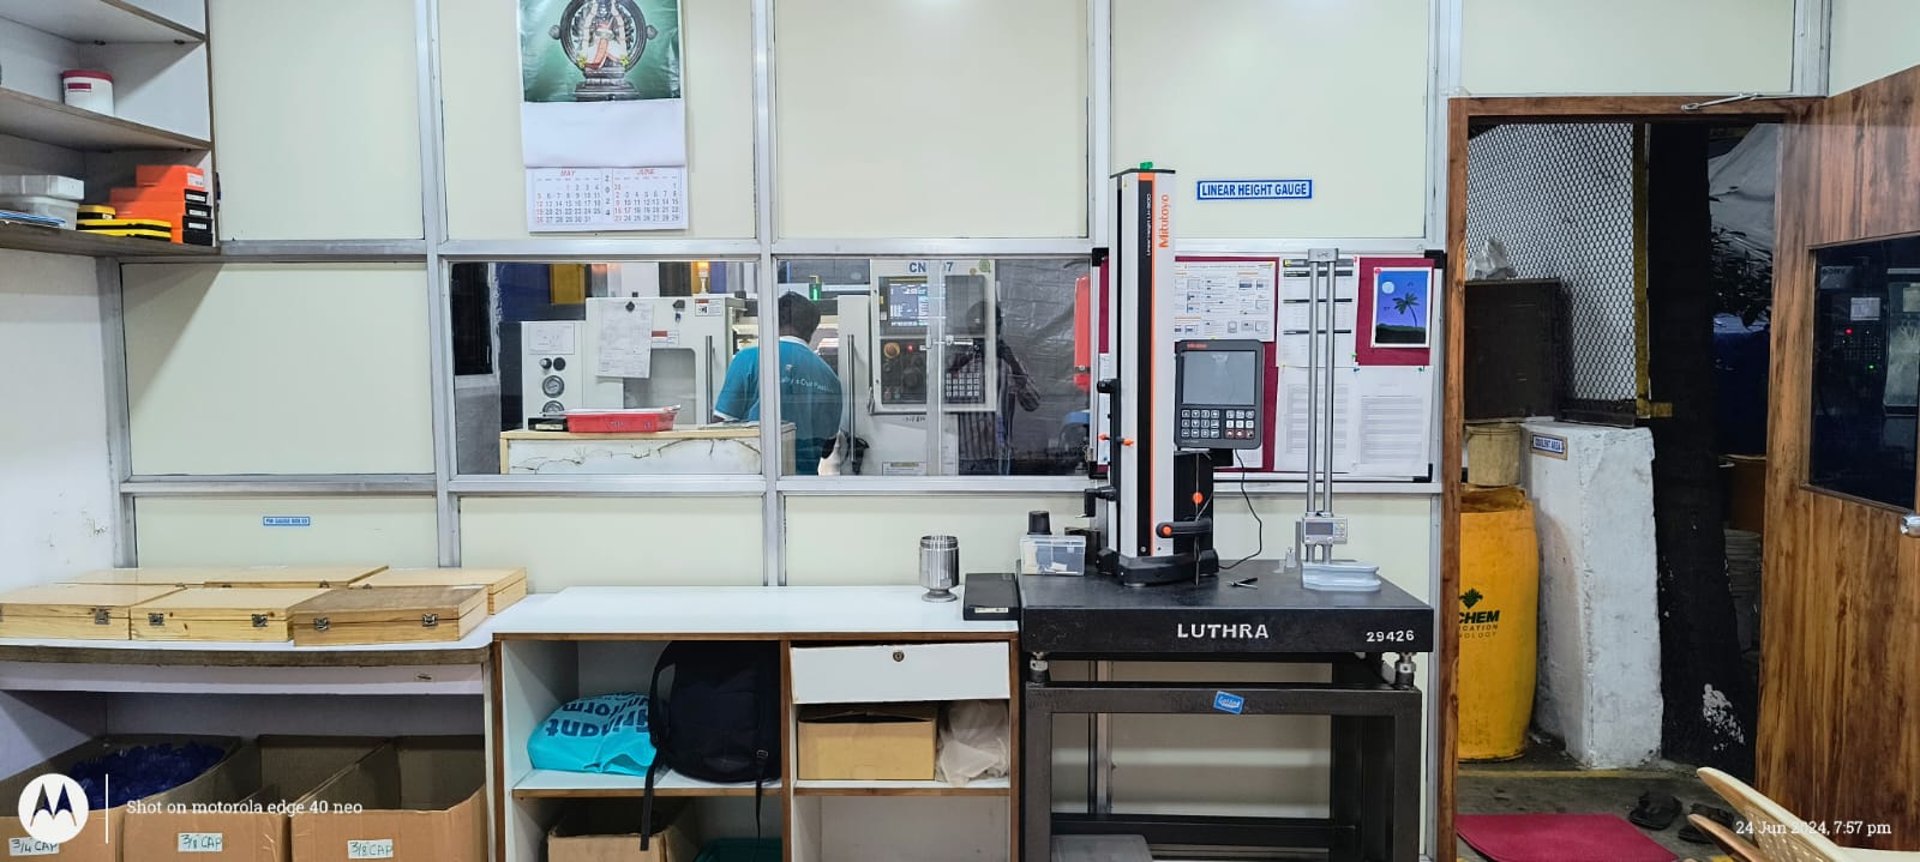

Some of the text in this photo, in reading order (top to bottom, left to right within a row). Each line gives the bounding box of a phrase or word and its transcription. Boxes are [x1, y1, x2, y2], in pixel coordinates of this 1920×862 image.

[561, 169, 576, 177] MAY
[1202, 183, 1307, 196] LINEAR HEIGHT GAUGE
[1159, 194, 1171, 248] Mitutoyo
[1177, 624, 1269, 638] LUTHRA
[1459, 624, 1498, 632] CATION
[1366, 630, 1415, 642] 29426
